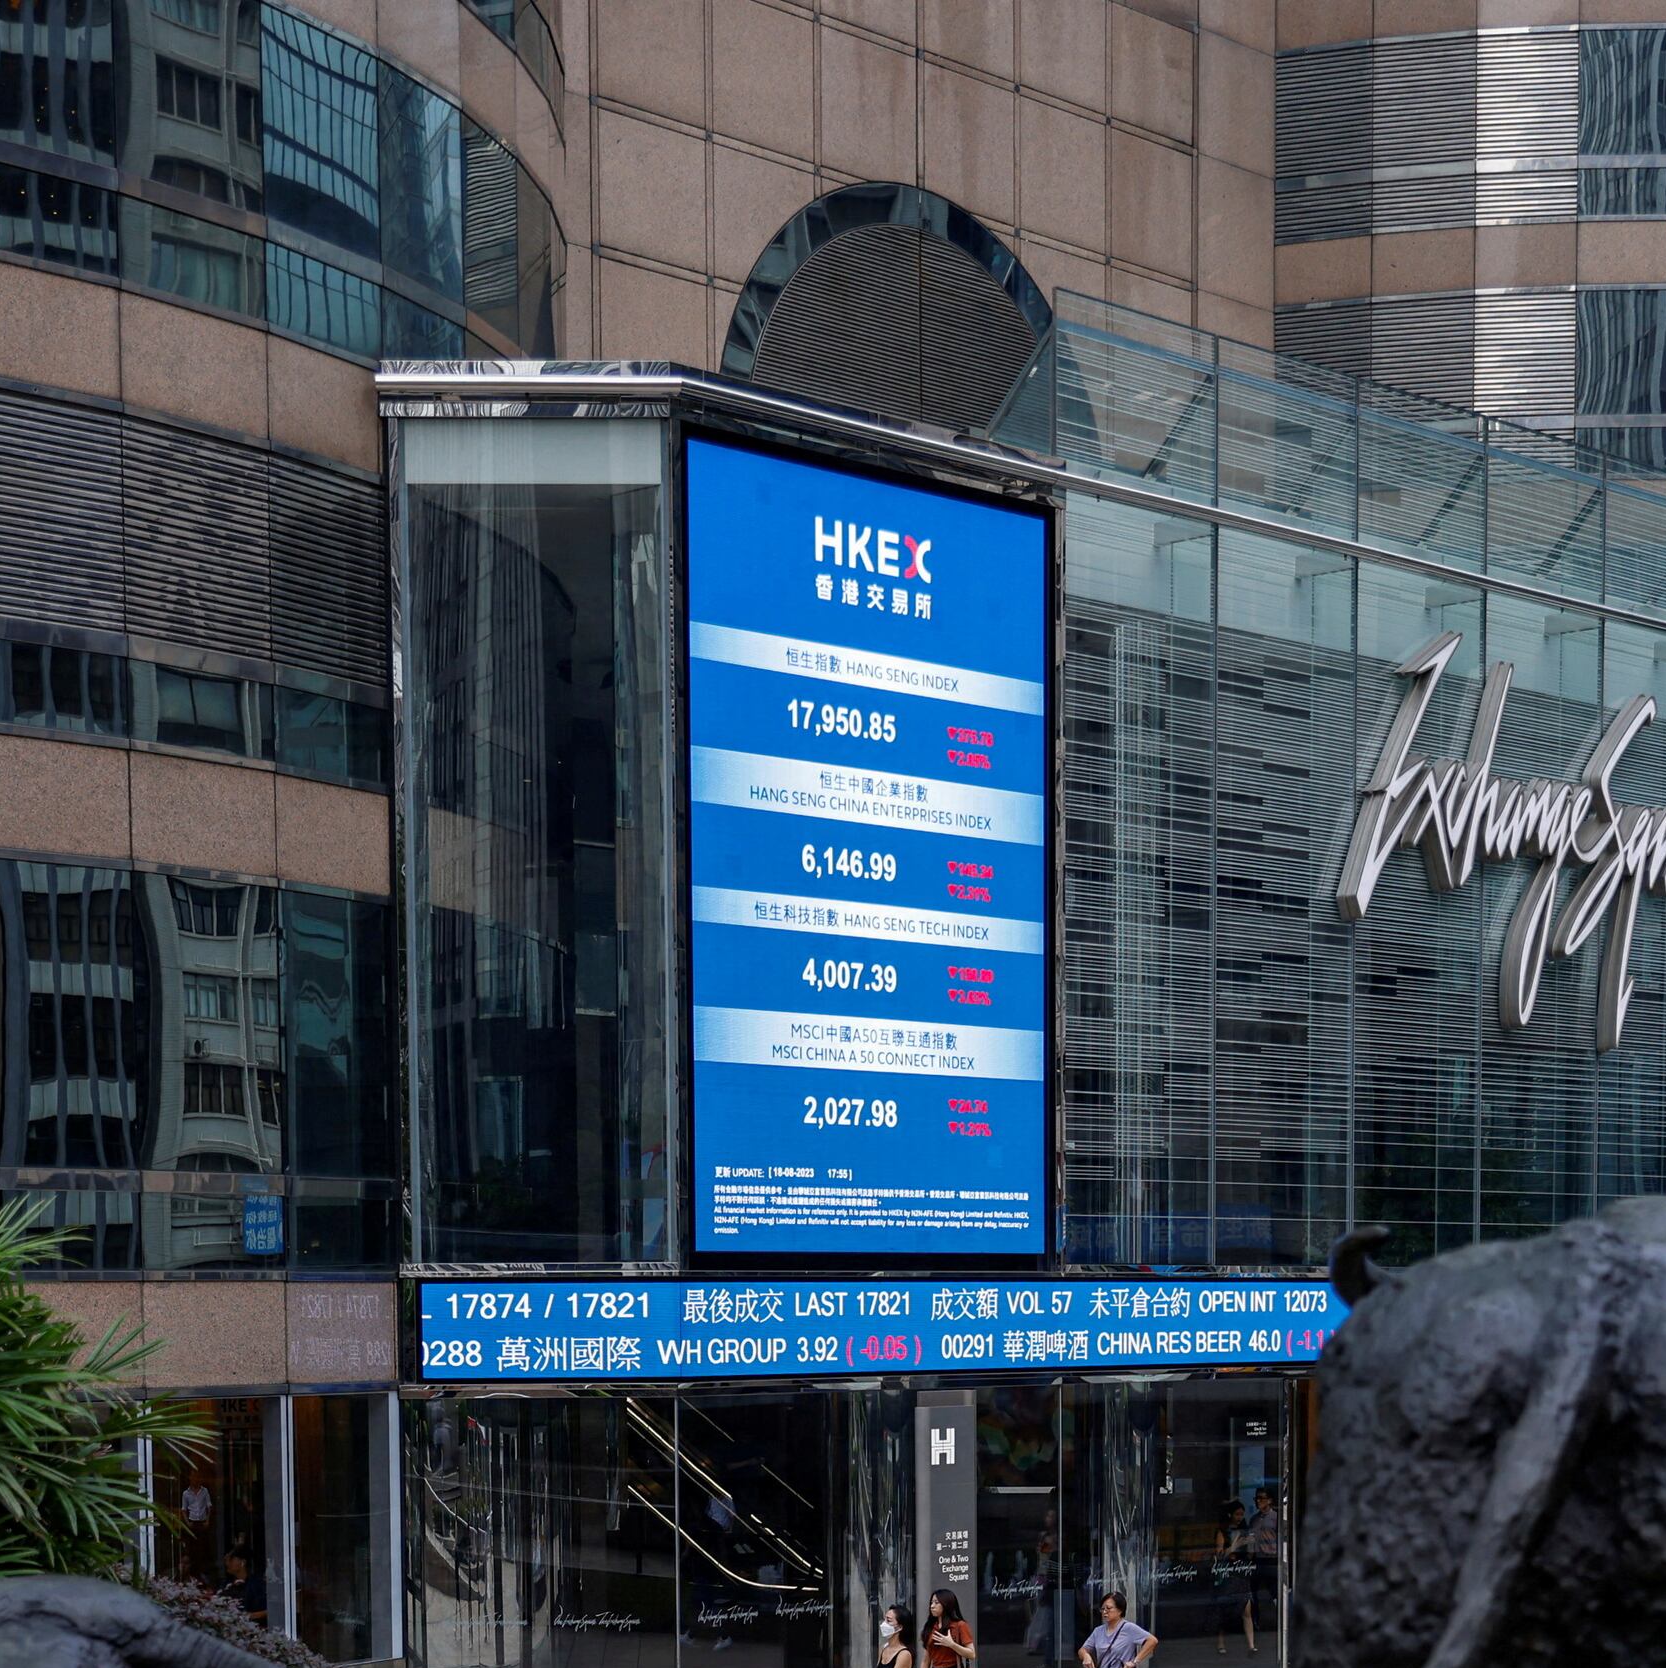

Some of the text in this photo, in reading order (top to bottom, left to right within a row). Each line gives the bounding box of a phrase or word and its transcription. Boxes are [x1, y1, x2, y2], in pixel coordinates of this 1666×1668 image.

[814, 516, 932, 584] HKEX
[815, 573, 932, 621] 香港交易所
[786, 646, 960, 694] 恒生指數 HANG SENG INDEX
[787, 698, 897, 743] 17,950.85
[819, 770, 929, 804] 恒生中國企業指數
[749, 785, 993, 831] HANG SENG CHINA ENTERPRISES INDEX
[801, 843, 897, 883] 6,146.99
[754, 900, 990, 942] 恒生科技指數 HANG SENG TECH INDEX
[802, 957, 897, 993] 4,007.39
[771, 1044, 975, 1071] MSCI CHINA A 50 CONNECT INDEX
[803, 1096, 898, 1131] 2,027.98
[446, 1286, 1328, 1324] 17874 / 17821 最後成交 LAST 17821 成交額 VOL 57 未平倉合約 OPEN INT 12073
[496, 1335, 642, 1373] 萬洲國際
[657, 1338, 702, 1365] WH
[707, 1337, 787, 1364] GROUP
[796, 1336, 839, 1363] 3.92
[941, 1334, 994, 1360] 00291
[1002, 1329, 1089, 1363] 華潤啤酒
[1096, 1332, 1151, 1357] CHINA
[1155, 1331, 1193, 1355] RES
[1196, 1330, 1242, 1355] BEER
[1248, 1329, 1281, 1354] 46.0
[938, 1555, 951, 1564] One
[957, 1554, 969, 1562] Two
[942, 1564, 969, 1573] Exchange
[949, 1573, 969, 1582] Square
